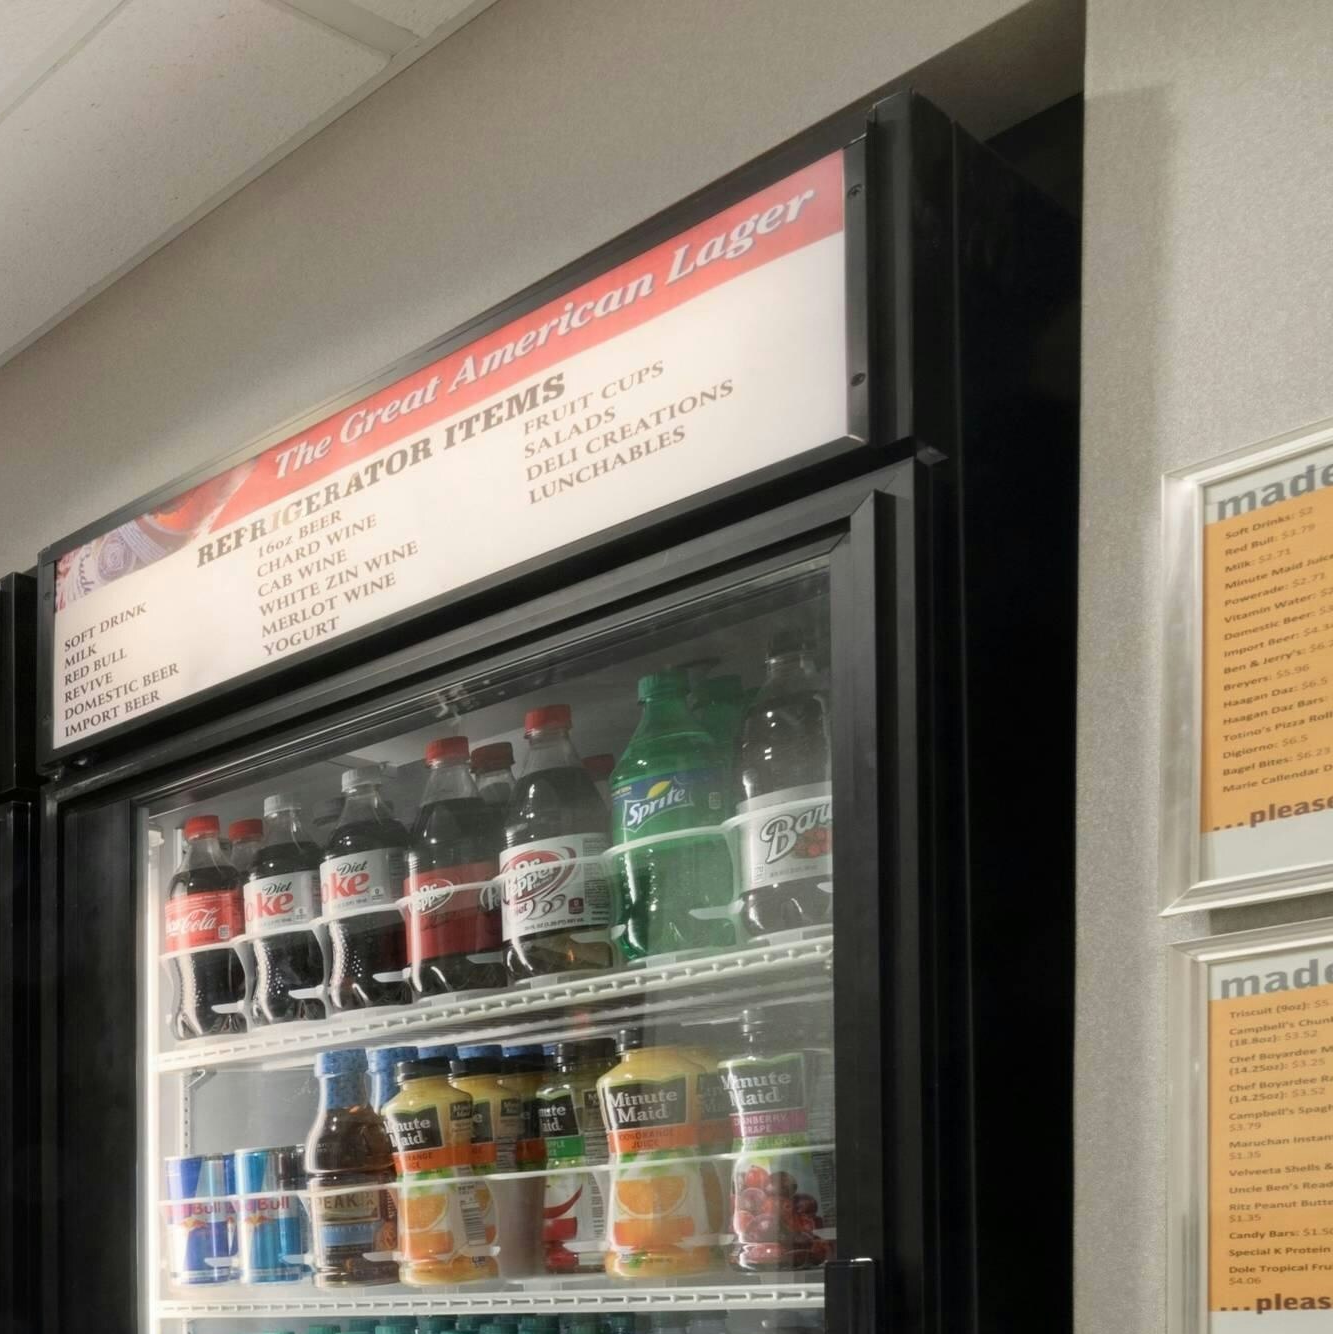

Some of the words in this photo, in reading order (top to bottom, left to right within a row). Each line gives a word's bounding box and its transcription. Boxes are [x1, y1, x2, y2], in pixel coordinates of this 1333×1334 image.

[274, 435, 332, 480] The
[340, 375, 442, 445] Great
[448, 272, 654, 393] American
[664, 188, 814, 286] Lager
[524, 392, 593, 436] FRUIT
[601, 360, 664, 399] CUPS
[524, 406, 616, 459] SALADS
[526, 447, 579, 481] DELI
[586, 379, 734, 455] CREATIONS
[196, 437, 433, 568] REFRIGERATOR
[443, 372, 566, 451] ITEMS
[529, 425, 686, 505] LUNCHABLES
[298, 510, 342, 539] BEER
[1225, 526, 1249, 540] Soft
[1252, 512, 1295, 531] Drinks:
[257, 540, 321, 578] CHARD
[327, 514, 377, 546] WINE
[1225, 543, 1248, 556] Red
[258, 574, 293, 597] CAB
[297, 548, 347, 580] WINE
[259, 582, 320, 617] WHITE
[325, 565, 359, 591] ZIN
[364, 540, 419, 573] WINE
[1225, 572, 1268, 590] Minute
[1271, 560, 1304, 576] Maid
[261, 595, 338, 638] MERLOT
[343, 571, 396, 603] WINE
[1225, 583, 1288, 607] Powerade:
[64, 626, 96, 652] SOFT
[99, 602, 147, 633] DRINK
[1224, 606, 1271, 623] Vitamin
[263, 616, 340, 657] YOGURT
[1224, 621, 1279, 641] Domestic
[64, 644, 97, 669] MILK
[1224, 641, 1264, 658] Import
[64, 665, 89, 685] RED
[93, 648, 128, 672] BULL
[64, 672, 113, 703] REVIVE
[64, 679, 139, 720] DOMESTIC
[142, 662, 180, 688] BEER
[1224, 674, 1272, 691] Breyers:
[64, 705, 120, 737] IMPORT
[124, 690, 160, 714] BEER
[1223, 763, 1255, 776] Bagel
[1223, 780, 1258, 793] Marie
[1261, 767, 1320, 786] Callendar
[627, 782, 687, 826] Sprite
[337, 860, 367, 875] Diet
[1229, 1007, 1272, 1019] Triscuit
[1229, 1021, 1294, 1036] Campbell's
[1259, 1047, 1317, 1061] Boyardee
[610, 1090, 678, 1110] Minute
[618, 1103, 669, 1125] Maid
[1229, 1167, 1281, 1177] Velveeta
[1285, 1162, 1321, 1173] Shells
[1229, 1231, 1266, 1240] Candy
